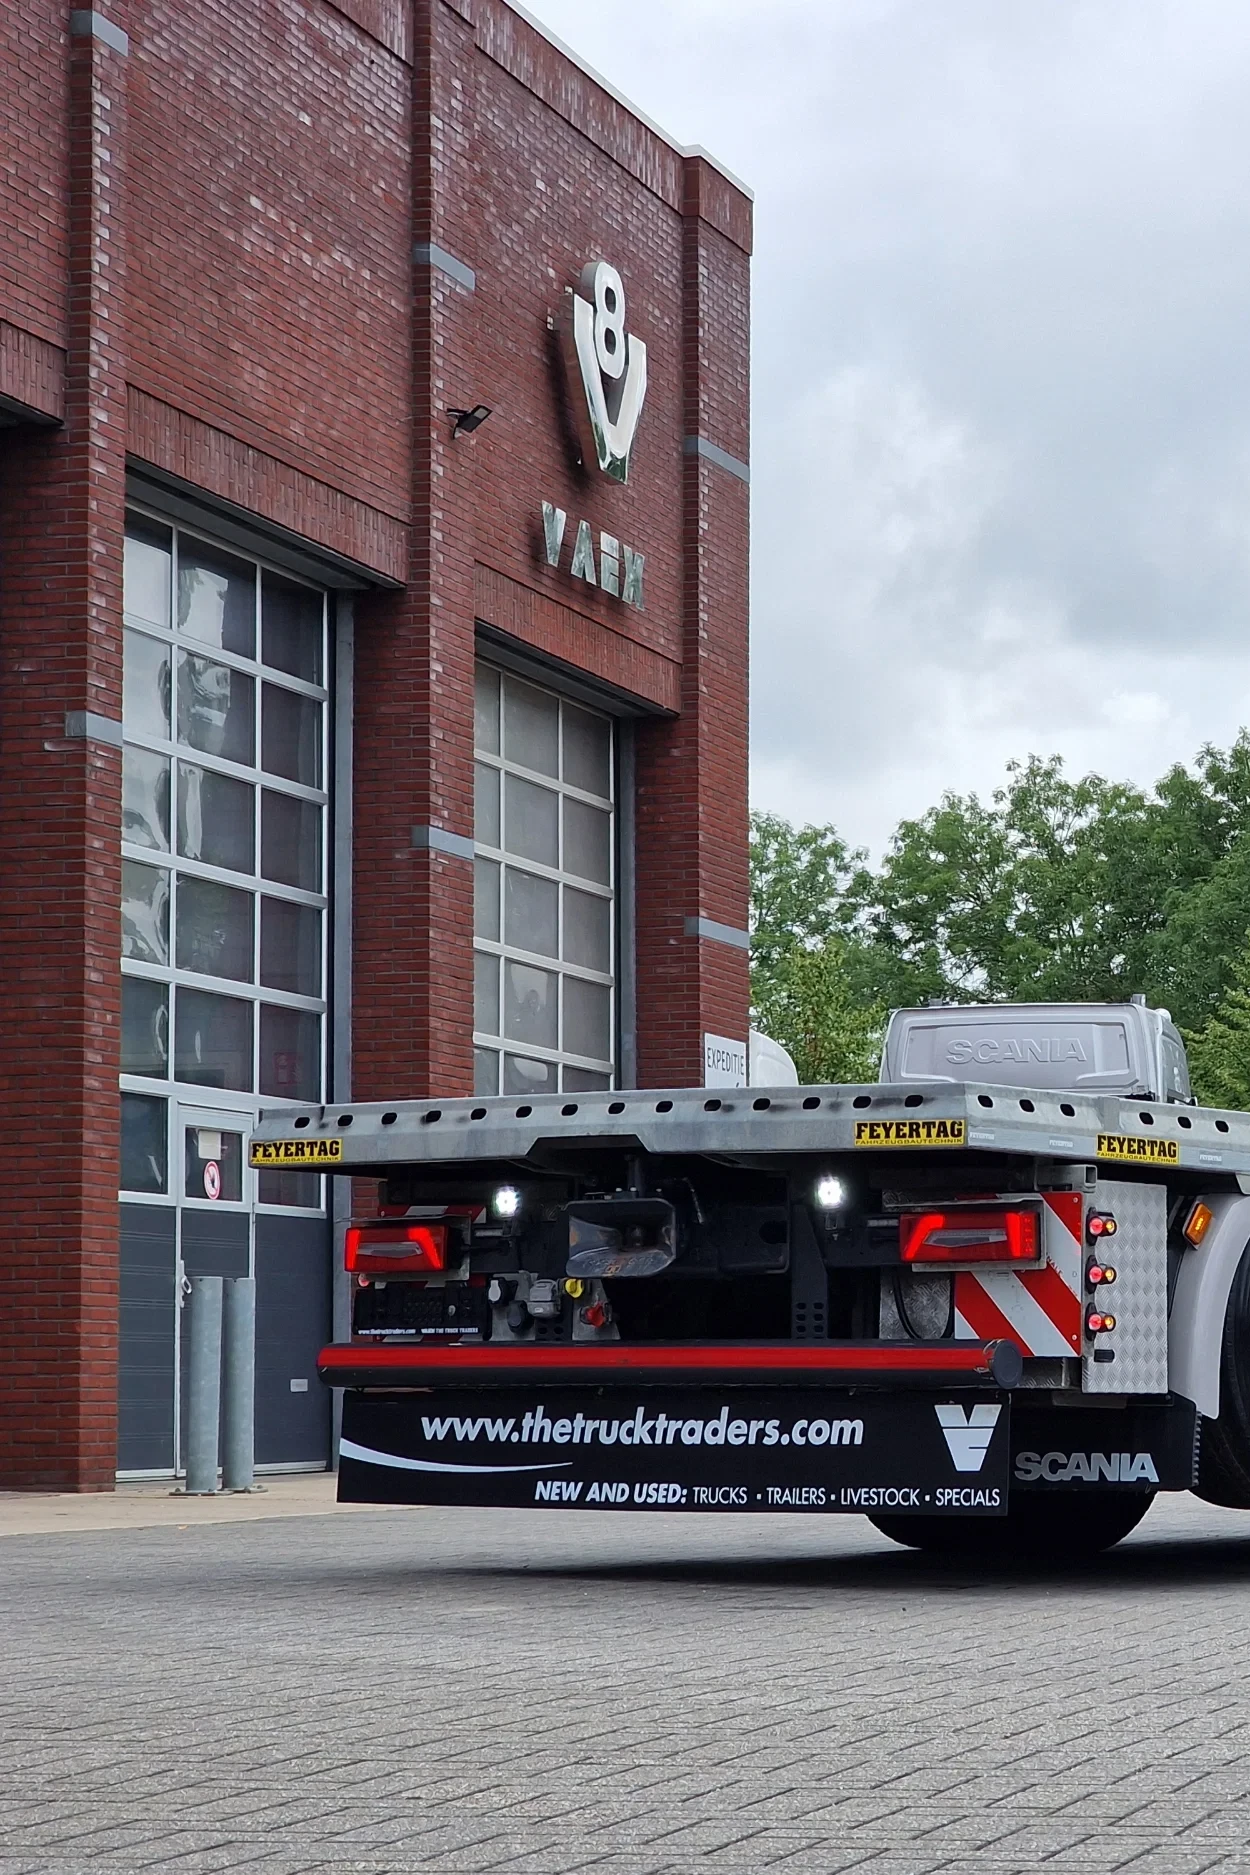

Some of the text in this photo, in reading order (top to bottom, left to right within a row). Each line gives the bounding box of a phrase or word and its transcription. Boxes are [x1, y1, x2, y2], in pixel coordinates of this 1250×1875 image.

[541, 499, 645, 612] VAEX
[707, 1046, 745, 1076] EXPEDITIE
[946, 1038, 1088, 1065] SCANIA
[855, 1121, 963, 1140] FEYERTAG
[251, 1140, 340, 1158] FEYERTAG
[1097, 1134, 1177, 1158] FEYERTAG
[420, 1405, 864, 1446] www.thetrucktraders.com
[1014, 1452, 1160, 1482] SCANIA
[534, 1481, 1001, 1507] NEW AND USED: TRUCKS TRAILERS LIVESTOCK SPECIALS
